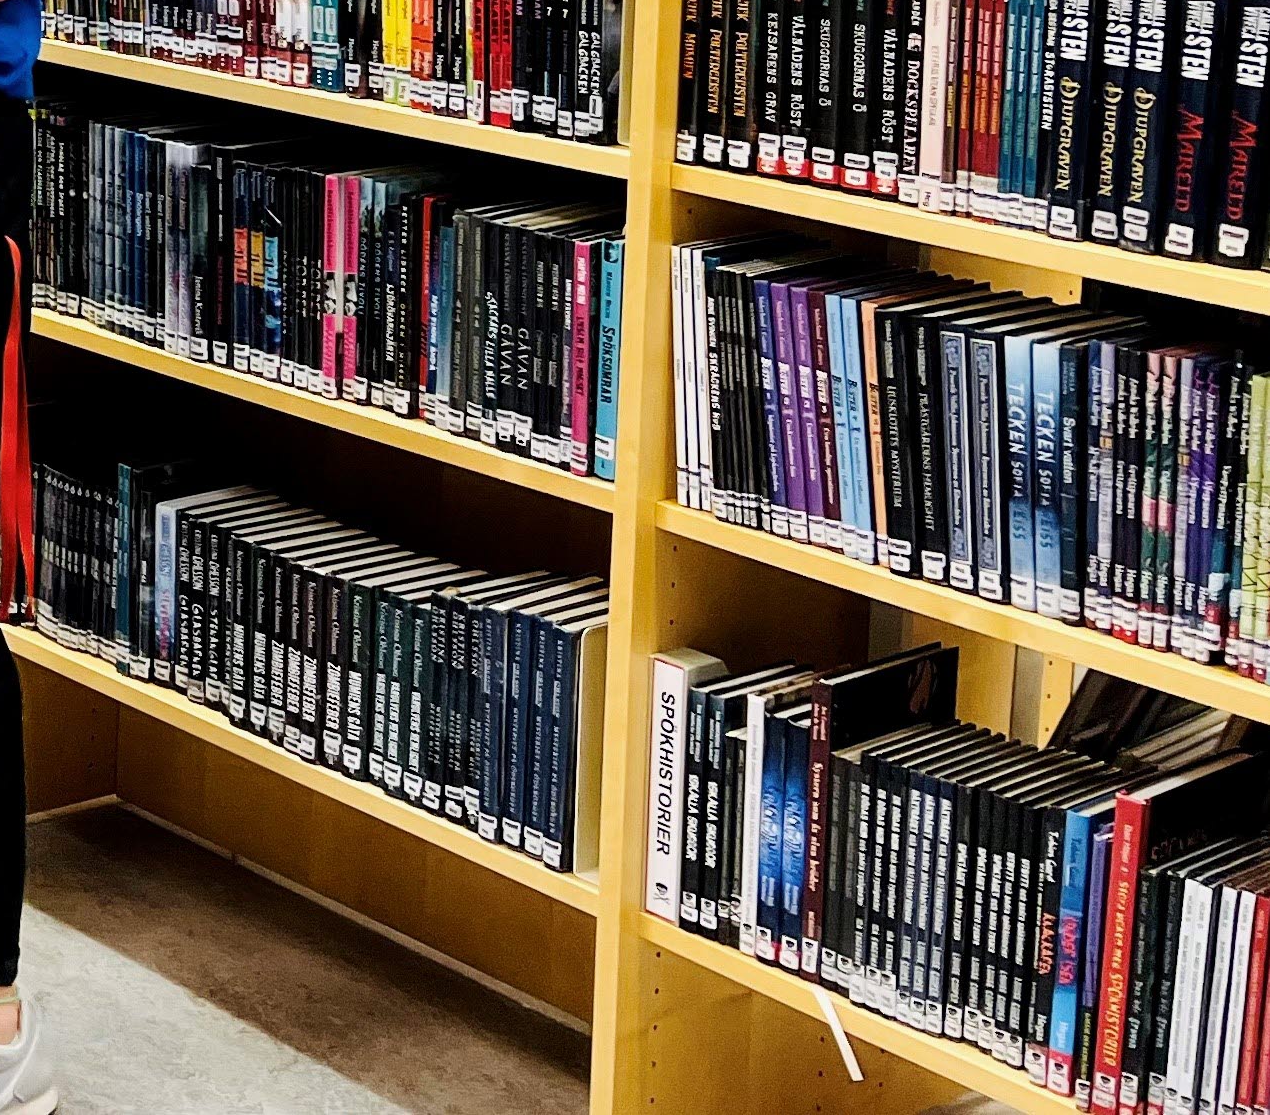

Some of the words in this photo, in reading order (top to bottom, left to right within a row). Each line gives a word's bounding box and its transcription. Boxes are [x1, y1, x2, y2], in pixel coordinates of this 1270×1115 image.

[766, 12, 778, 83] KEJSARENS
[791, 15, 806, 85] VÅLNADENS
[819, 19, 831, 92] SKUGGORNAS
[853, 24, 865, 98] SKUGGORNAS
[882, 29, 897, 101] VÅLNADENS
[1060, 17, 1088, 61] STEN
[1103, 22, 1132, 67] STEN
[1135, 27, 1165, 72] STEN
[1181, 34, 1212, 80] STEN
[1236, 41, 1268, 88] STEN
[765, 92, 776, 122] GRAV
[790, 94, 804, 126] RÖST
[881, 109, 896, 143] RÖST
[902, 60, 919, 175] DOCKSPELAREN
[1055, 77, 1081, 190] DJUPGRAVEN
[1097, 82, 1124, 196] DJUPGRAVEN
[1128, 87, 1156, 203] DJUPGRAVEN
[500, 323, 512, 386] GÅVAN
[517, 327, 529, 390] GÅVAN
[1008, 384, 1026, 454] TECKEN
[1037, 392, 1055, 462] TECKEN
[656, 692, 678, 855] SPÖKHISTORIER
